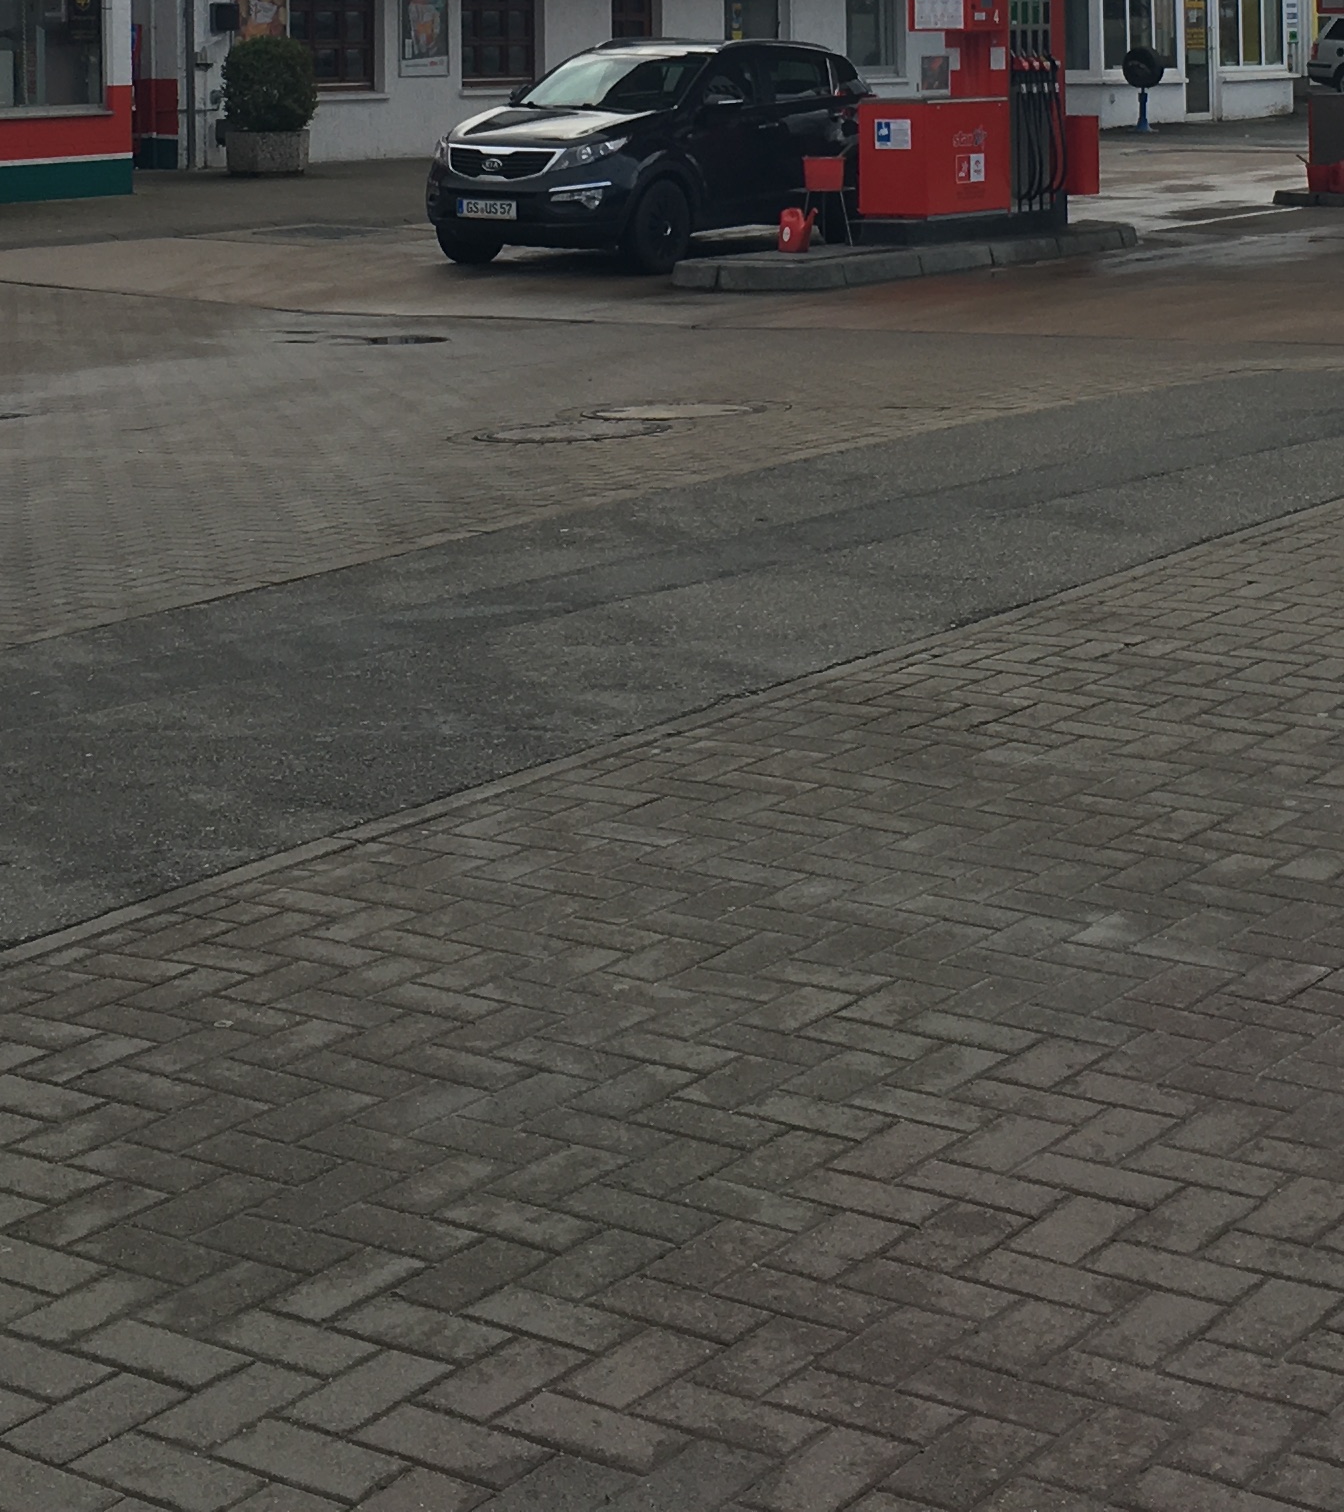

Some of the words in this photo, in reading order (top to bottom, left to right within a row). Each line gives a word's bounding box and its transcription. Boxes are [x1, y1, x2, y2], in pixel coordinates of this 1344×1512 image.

[993, 9, 1000, 24] 4
[485, 161, 499, 169] KIA
[466, 201, 479, 214] GS
[485, 202, 498, 215] US
